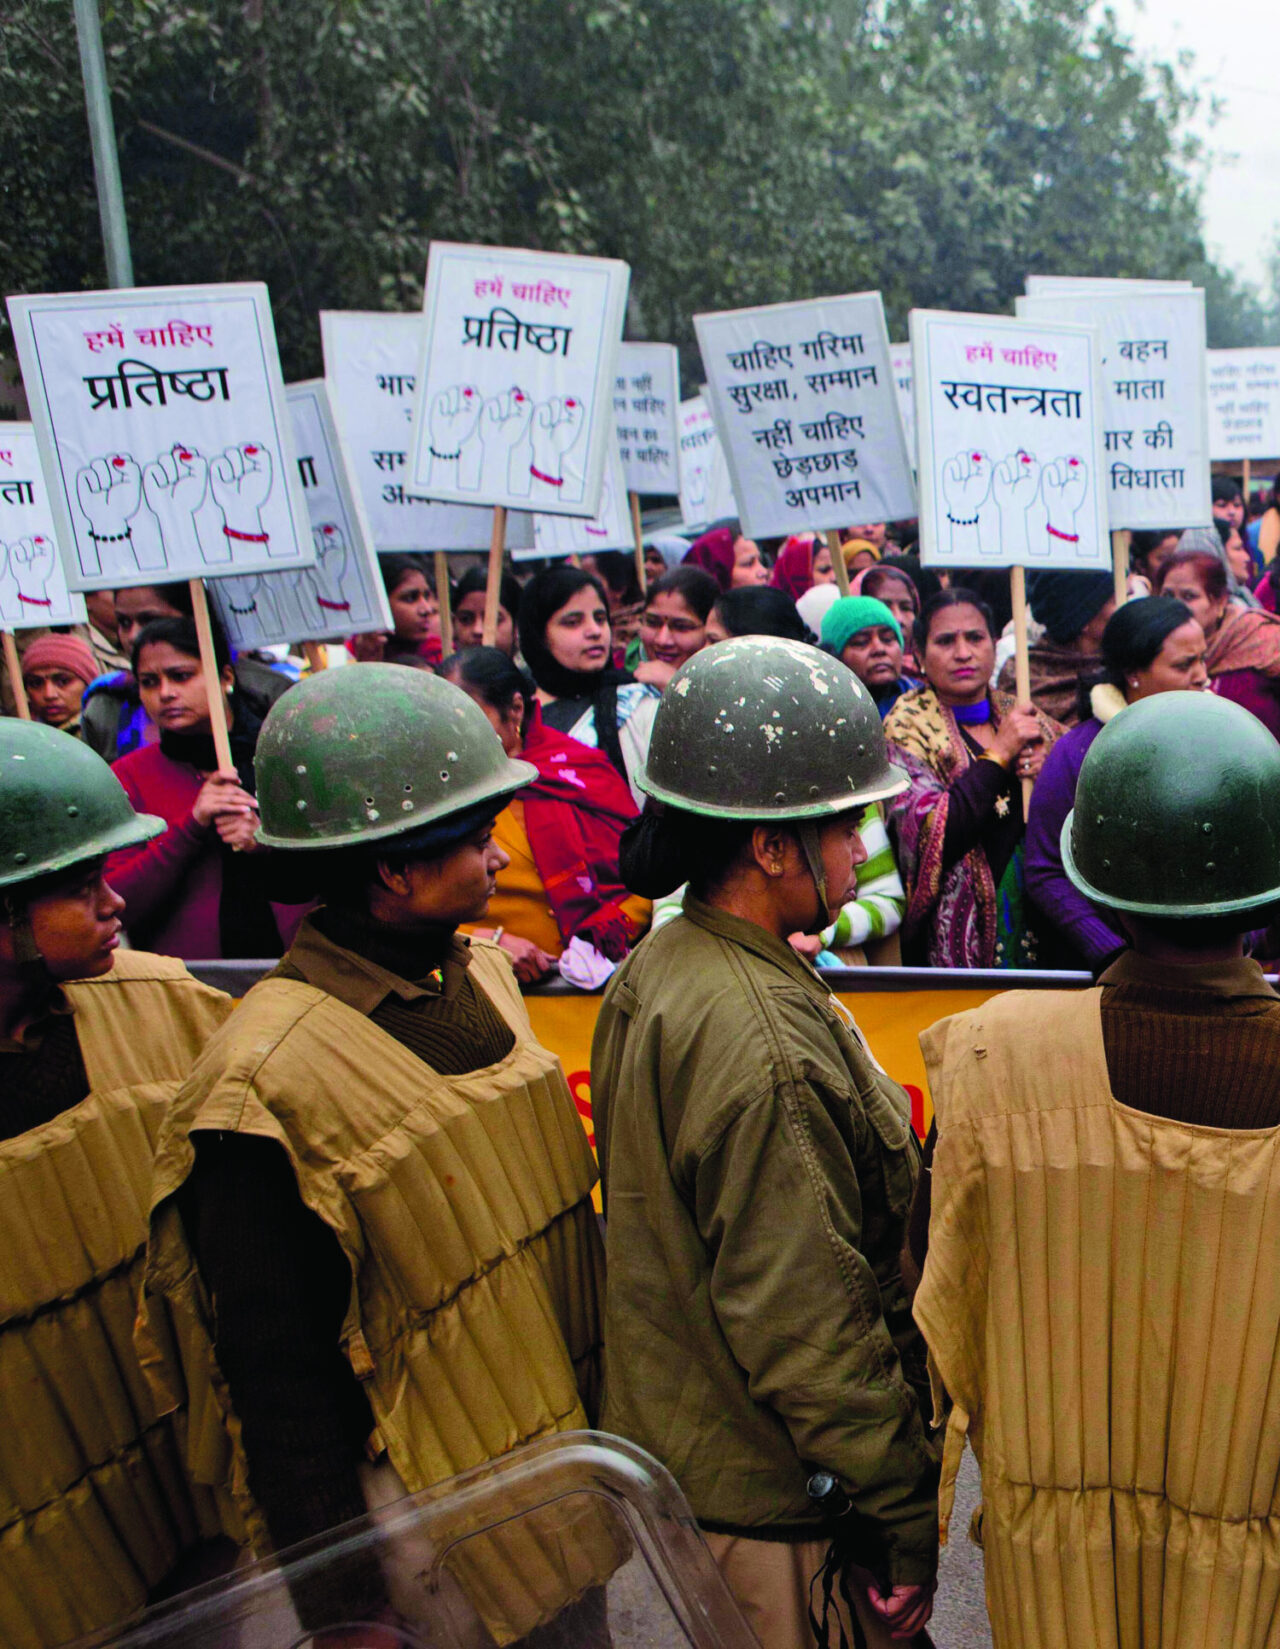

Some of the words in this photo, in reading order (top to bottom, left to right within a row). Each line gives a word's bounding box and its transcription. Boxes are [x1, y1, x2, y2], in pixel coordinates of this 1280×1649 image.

[473, 275, 503, 299] हमें
[511, 281, 571, 308] चाहिए
[83, 323, 125, 353] हमें
[133, 320, 214, 349] चाहिए
[461, 307, 572, 357] प्रतिष्ठा
[727, 340, 794, 373] चाहिए
[799, 330, 865, 361] गरिमा
[965, 343, 994, 365] हमें
[1003, 345, 1058, 371] चाहिए
[82, 359, 230, 410] प्रतिष्ठा
[804, 365, 879, 395] सम्मान
[1113, 379, 1165, 401] माता
[940, 380, 1082, 420] स्वतन्त्रता
[752, 418, 794, 450] नहीं
[800, 411, 866, 442] चाहिए
[1143, 420, 1174, 449] की
[772, 449, 858, 480] छेड़छाड़
[1110, 461, 1185, 491] विधाता
[786, 480, 861, 509] अपमान
